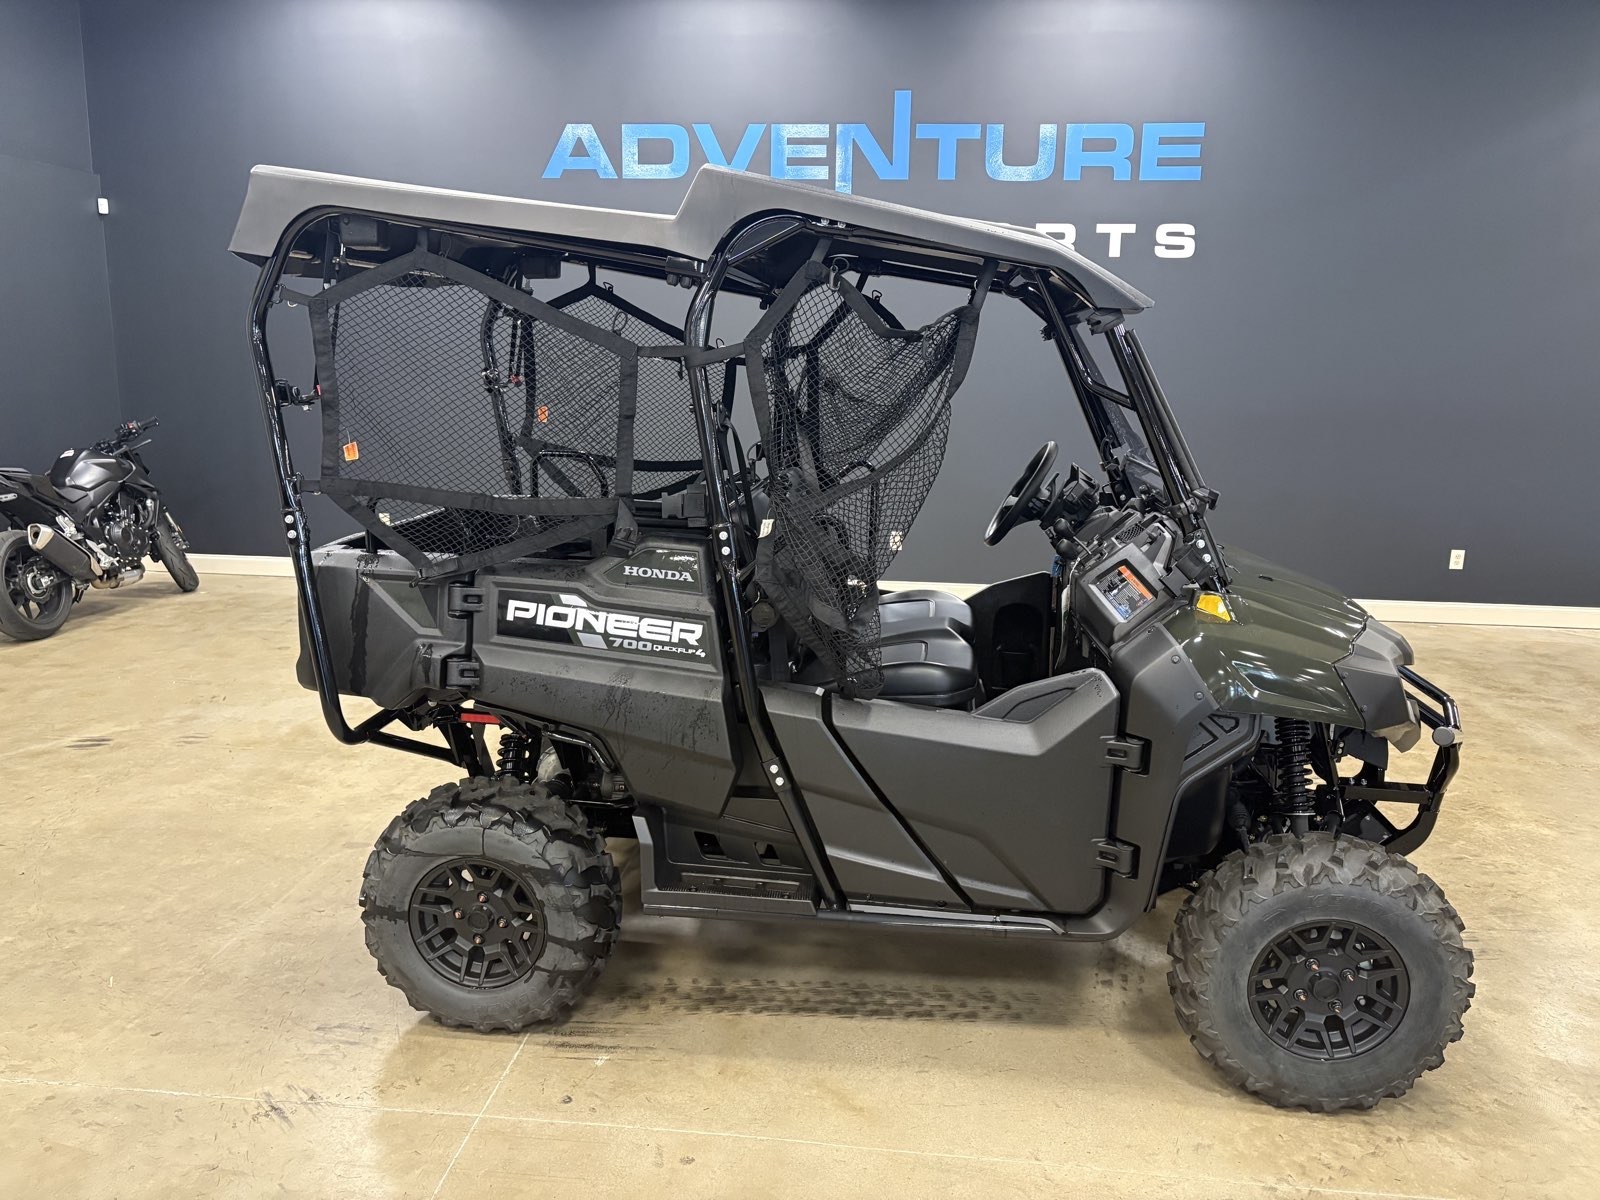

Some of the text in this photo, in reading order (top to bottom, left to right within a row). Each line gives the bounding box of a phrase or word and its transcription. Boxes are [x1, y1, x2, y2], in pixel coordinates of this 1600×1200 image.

[541, 89, 1206, 195] ADVENTURE
[1035, 223, 1196, 258] RTS
[623, 565, 695, 583] HONDA
[506, 599, 704, 646] PIONEER
[609, 637, 653, 652] 700
